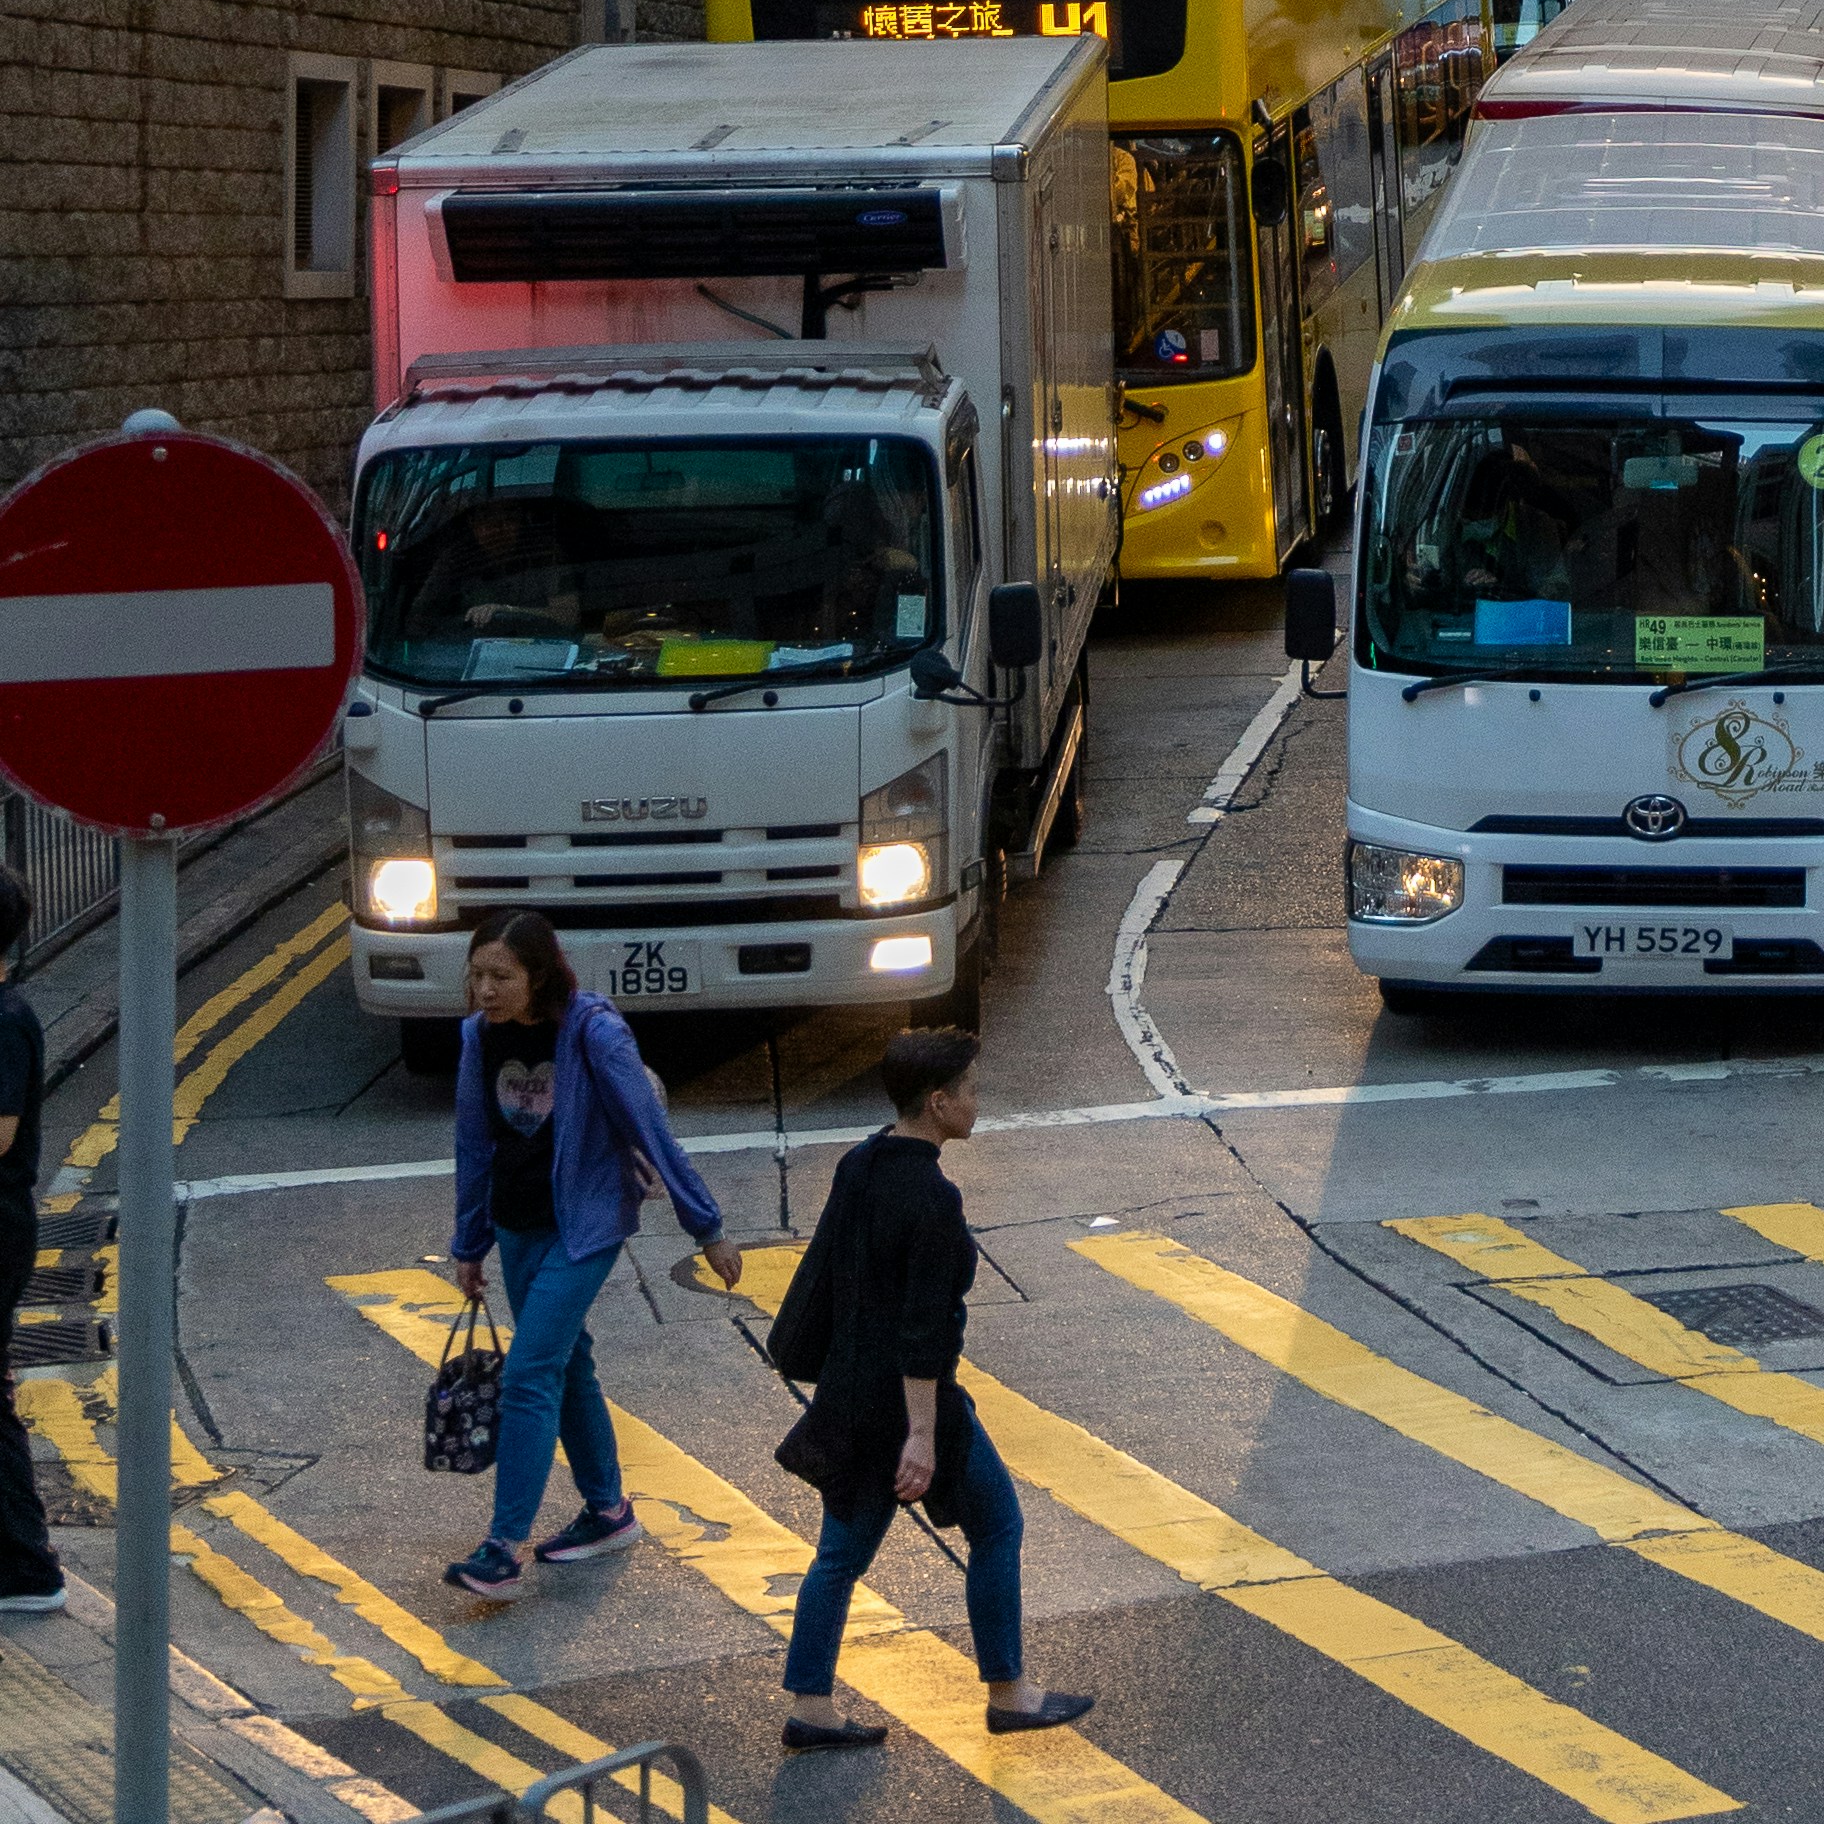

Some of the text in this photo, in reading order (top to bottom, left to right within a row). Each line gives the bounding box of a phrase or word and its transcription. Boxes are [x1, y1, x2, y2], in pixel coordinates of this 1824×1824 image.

[581, 797, 708, 821] ISUZU
[1584, 925, 1724, 954] YH 5529
[623, 941, 667, 968] ZK
[609, 967, 688, 995] 1899
